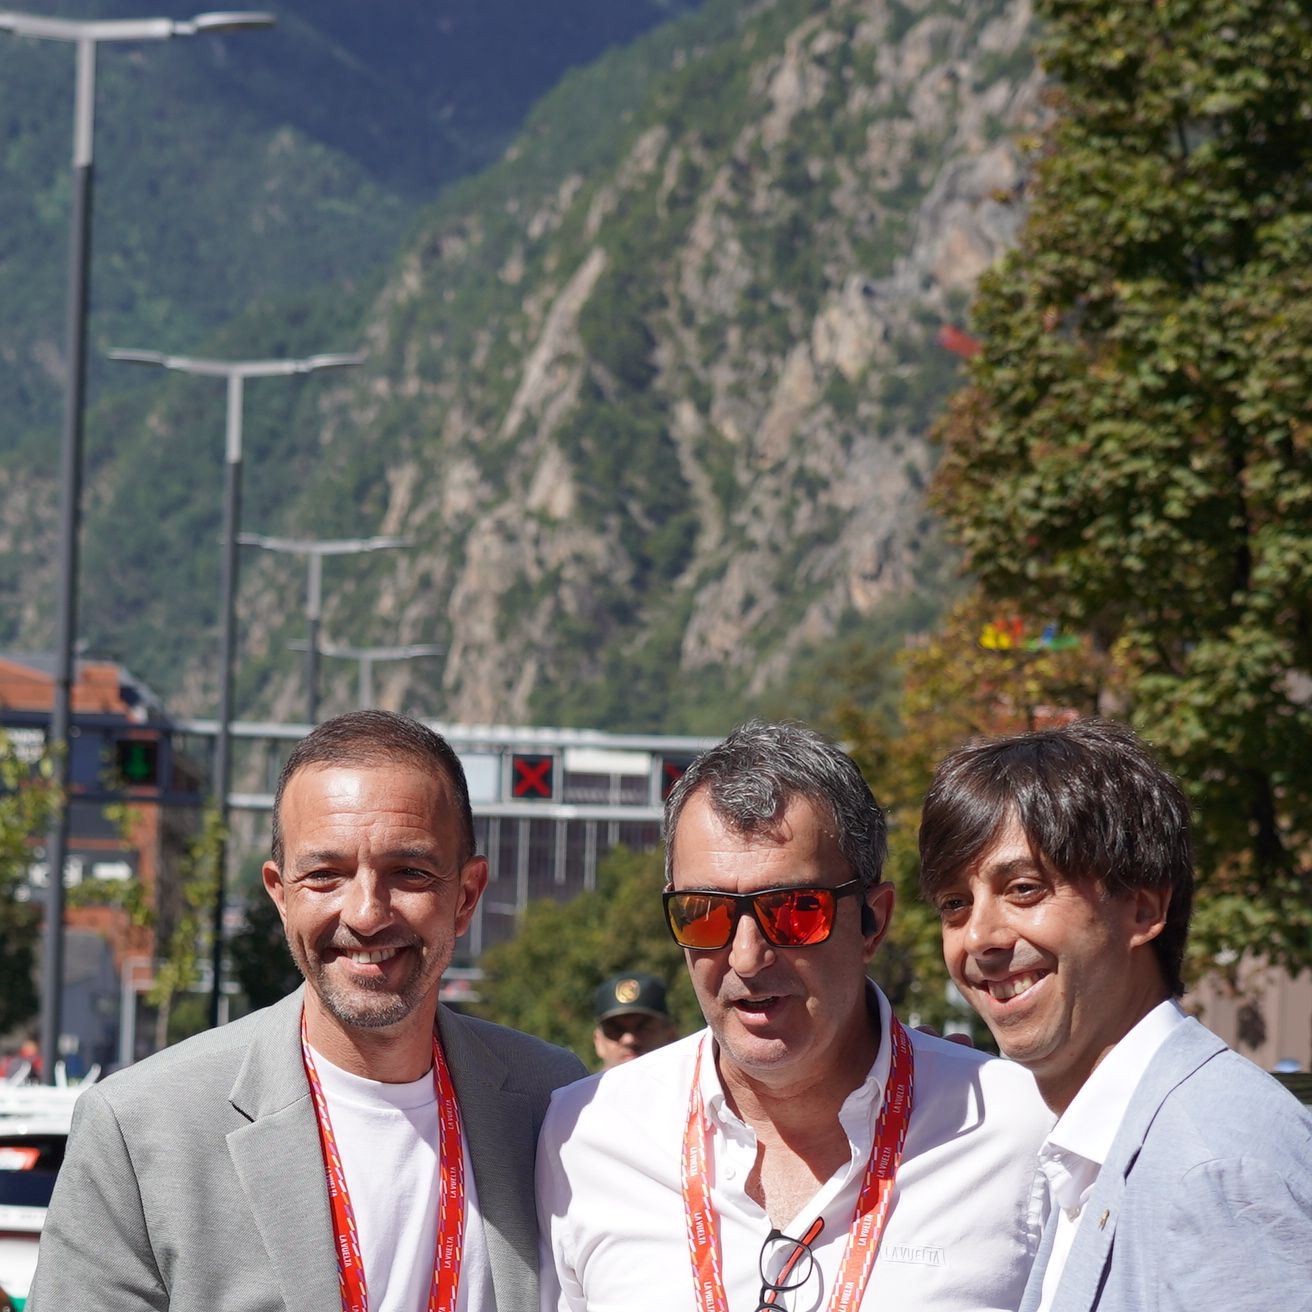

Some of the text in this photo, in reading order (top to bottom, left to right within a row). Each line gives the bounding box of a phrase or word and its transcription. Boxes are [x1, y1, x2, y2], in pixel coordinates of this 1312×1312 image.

[895, 1084, 905, 1107] VUELTA
[880, 1147, 892, 1171] VUELTA
[695, 1220, 706, 1245] VUELTA
[859, 1214, 873, 1239] VUELTA
[341, 1242, 352, 1267] VUELTA
[445, 1236, 454, 1261] VUELTA
